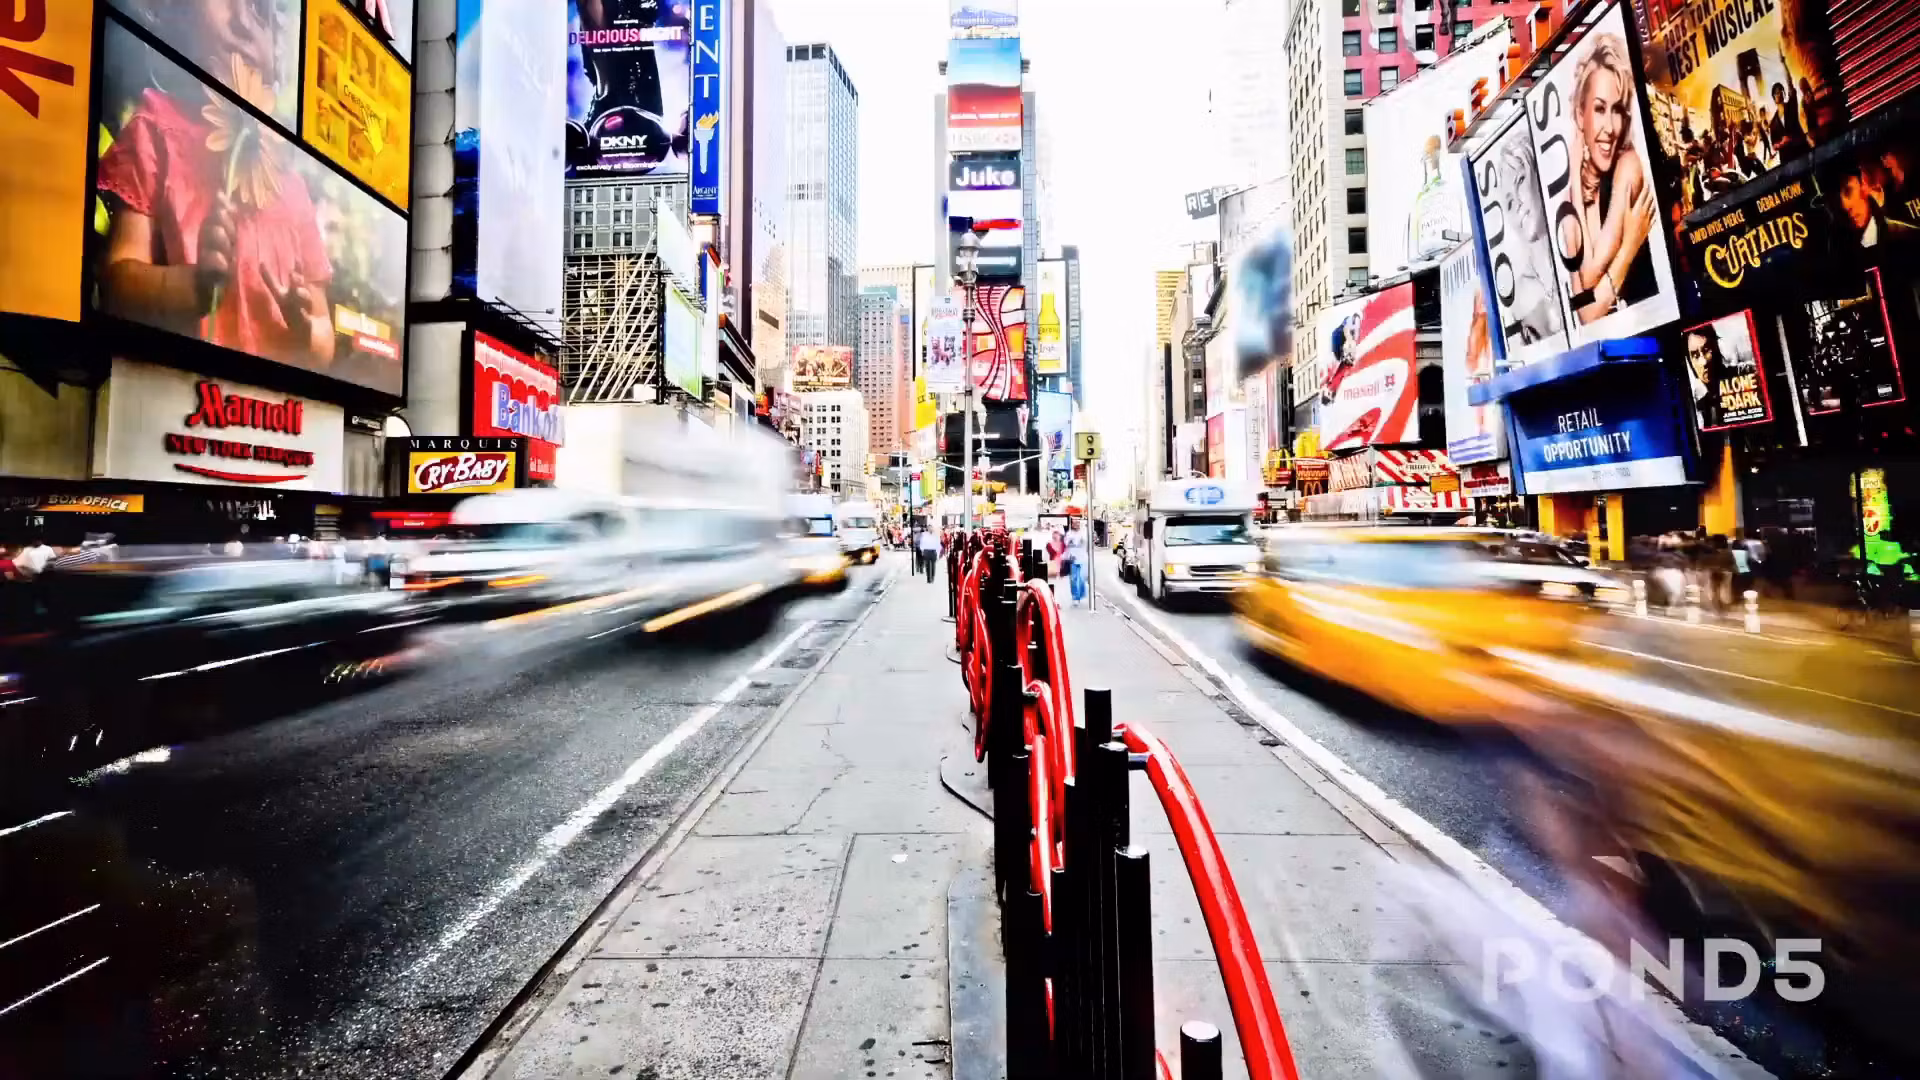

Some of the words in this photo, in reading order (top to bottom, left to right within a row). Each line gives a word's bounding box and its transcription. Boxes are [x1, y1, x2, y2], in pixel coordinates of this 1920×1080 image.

[568, 28, 639, 45] DELICIOUS
[1667, 33, 1700, 86] BEST
[600, 135, 647, 147] DKNY
[1719, 373, 1758, 396] ALONE
[184, 380, 303, 436] Marriott
[492, 381, 543, 439] Bank
[1728, 391, 1763, 412] DARK
[1558, 408, 1604, 434] RETAIL
[409, 438, 518, 449] MARQUIS
[1543, 431, 1632, 464] OPPORTUNITY
[415, 452, 509, 490] CRY-BABY
[81, 496, 129, 510] OFFICE
